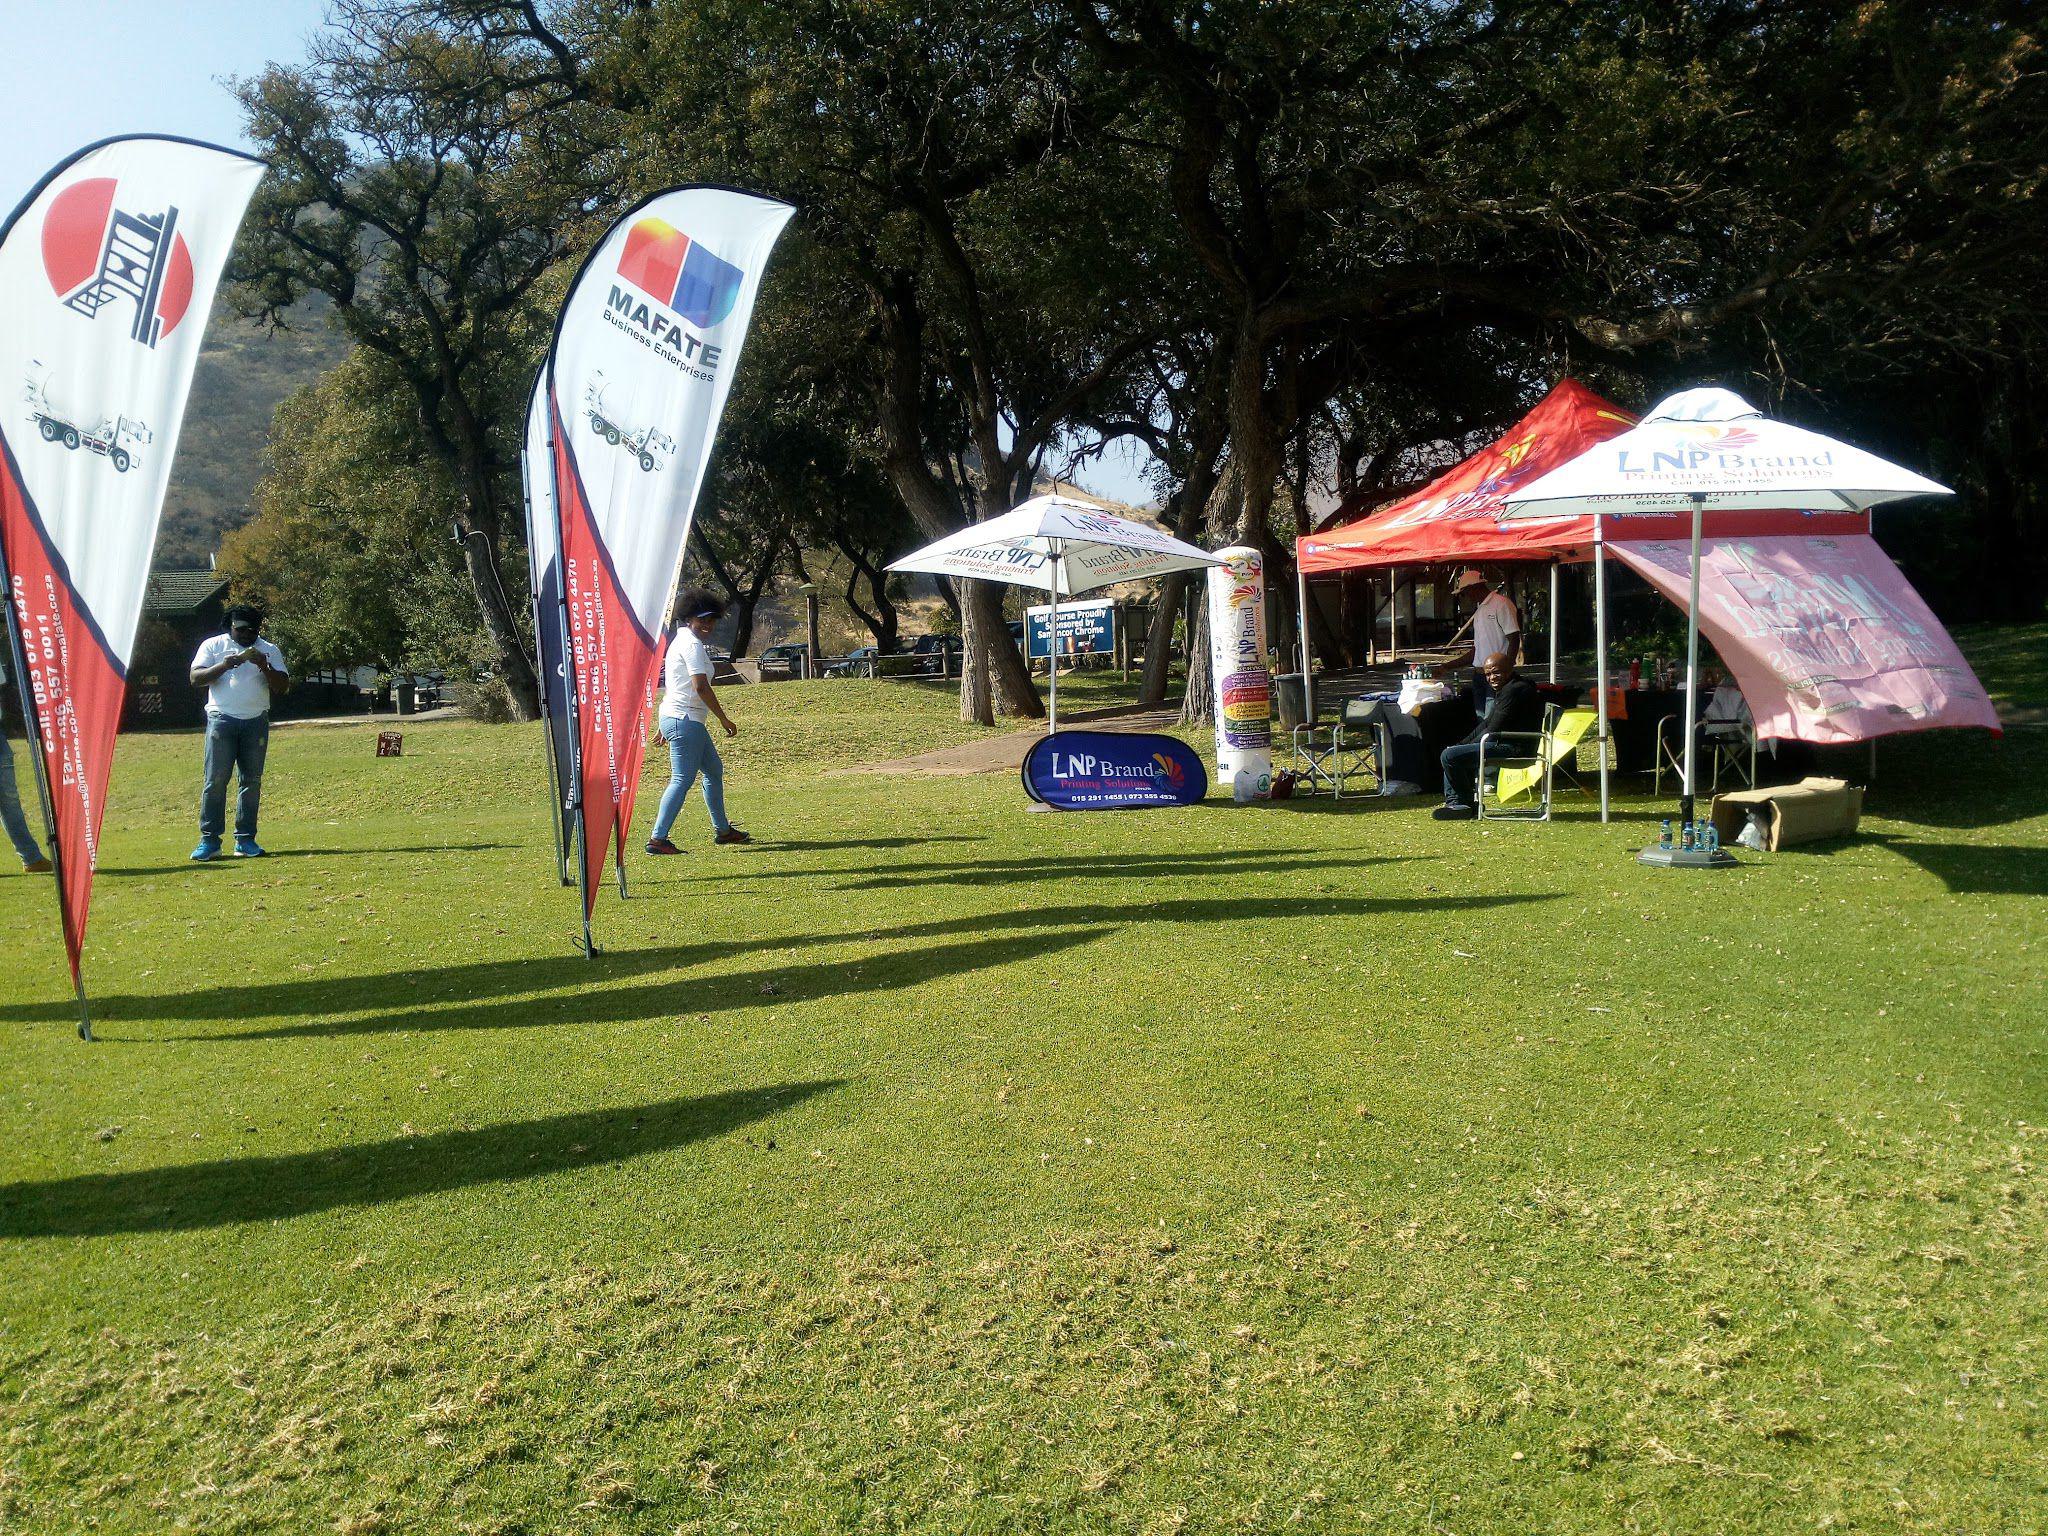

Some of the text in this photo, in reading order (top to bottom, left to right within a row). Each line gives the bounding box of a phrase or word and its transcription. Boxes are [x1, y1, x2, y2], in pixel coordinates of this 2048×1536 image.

[606, 284, 722, 370] MAFATE
[603, 310, 714, 383] Business Enterprises
[1618, 450, 1833, 472] LNP Brand
[13, 574, 28, 623] 4470
[1034, 614, 1049, 623] Golf
[1077, 608, 1107, 618] Proudly
[36, 614, 54, 660] 0011
[568, 559, 587, 705] Cell: 083 079 4470
[1037, 625, 1104, 639] Samncor Chrome
[1045, 618, 1095, 630] Sonsored by
[1240, 607, 1255, 637] Brand
[583, 591, 602, 733] Fax: 086 557 0011
[31, 669, 47, 705] 083
[46, 664, 63, 699] 557
[39, 710, 55, 753] Cell:
[1052, 752, 1154, 778] LNP Brand
[1061, 778, 1151, 791] Printing Solutions
